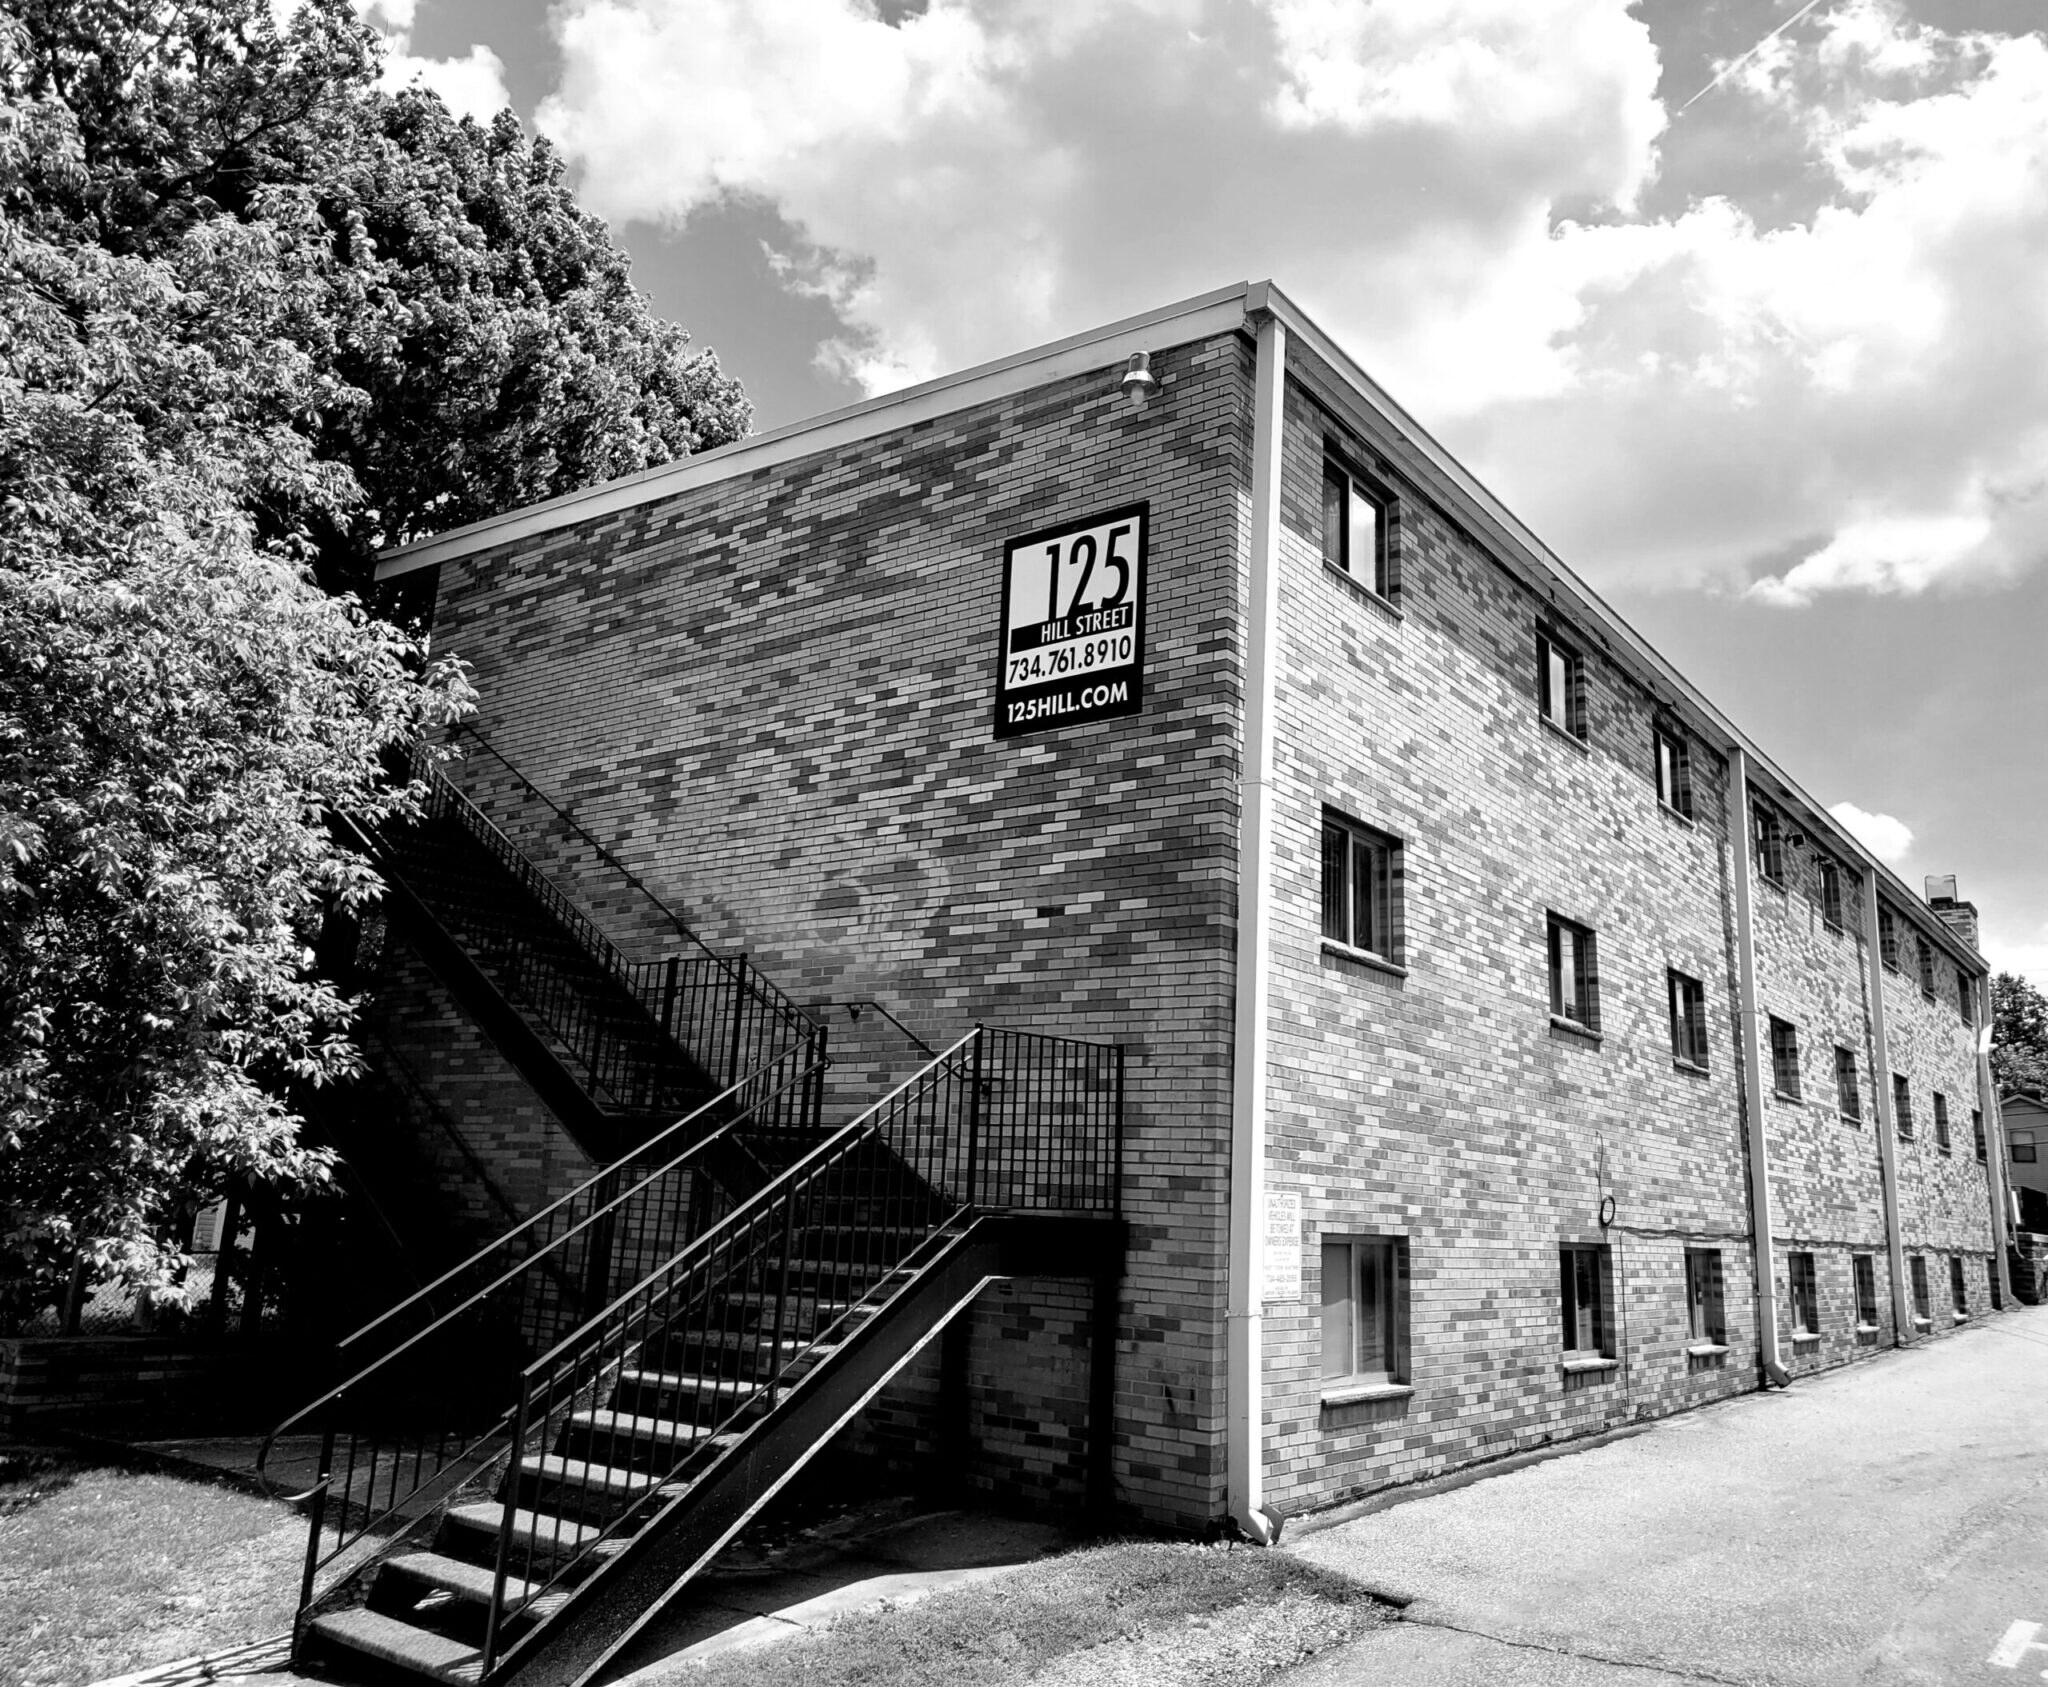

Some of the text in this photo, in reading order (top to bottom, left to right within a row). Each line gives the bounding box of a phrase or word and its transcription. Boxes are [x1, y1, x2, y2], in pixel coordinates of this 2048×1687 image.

[1046, 524, 1131, 621] 125
[1041, 606, 1129, 643] HILL STREET
[1009, 635, 1132, 684] 734.761.8910
[1007, 681, 1128, 723] 125HILL.COM
